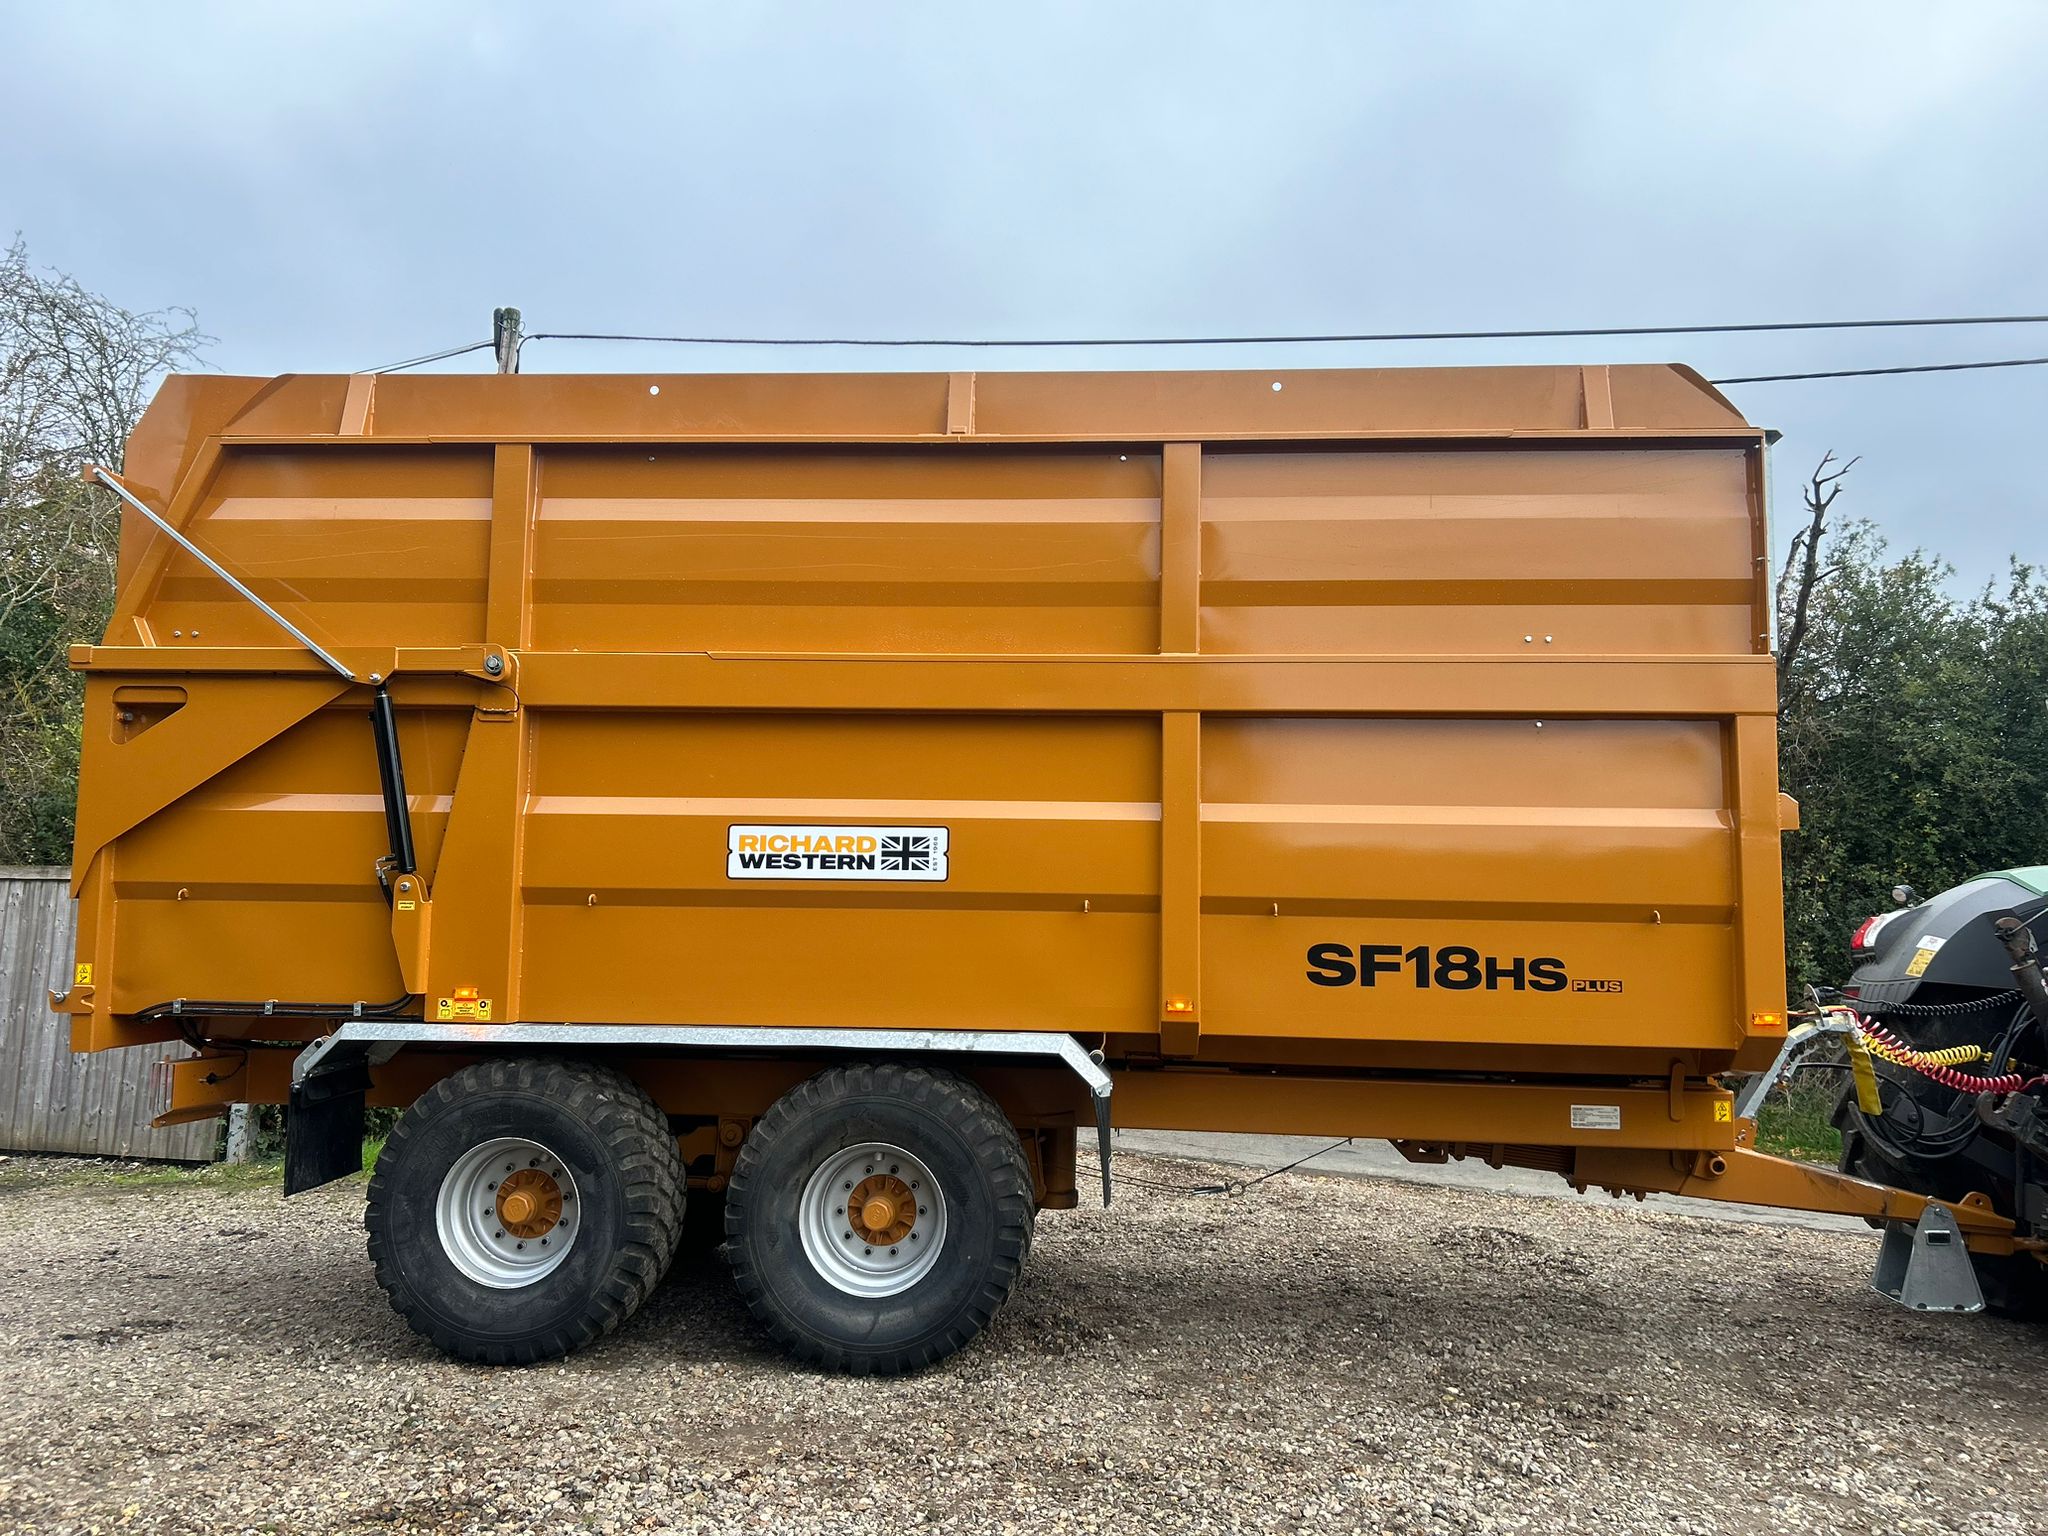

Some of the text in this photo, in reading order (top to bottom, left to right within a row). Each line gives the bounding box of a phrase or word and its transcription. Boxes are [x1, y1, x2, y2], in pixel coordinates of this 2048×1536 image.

[738, 834, 877, 853] RICHARD
[739, 853, 875, 871] WESTERN
[1573, 980, 1622, 993] PLUS
